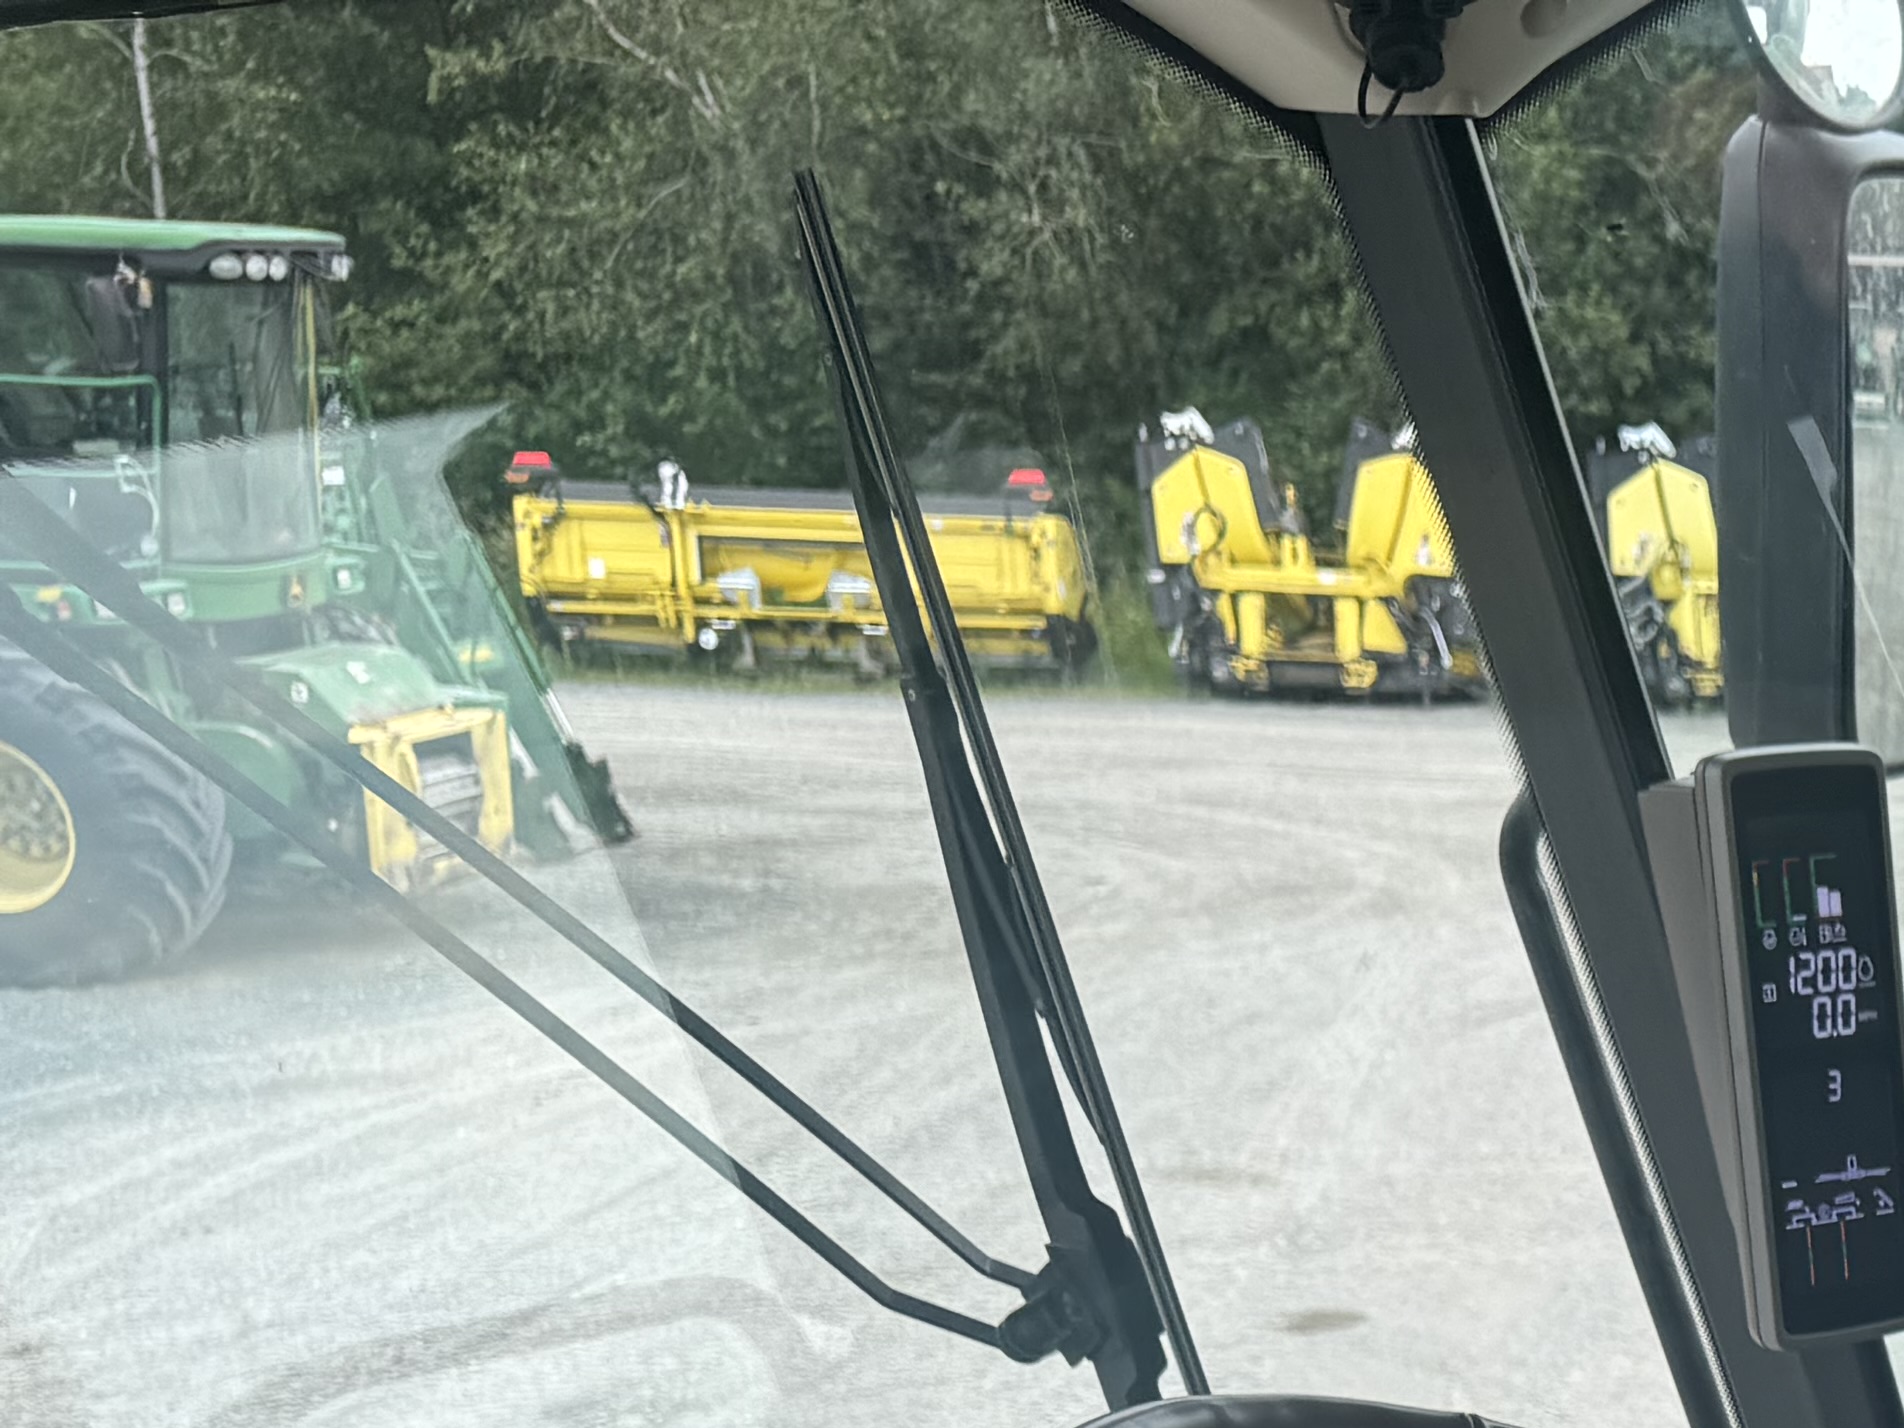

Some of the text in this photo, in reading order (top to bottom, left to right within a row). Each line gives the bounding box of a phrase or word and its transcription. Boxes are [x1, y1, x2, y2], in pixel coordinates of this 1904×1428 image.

[1789, 948, 1857, 994] 1200
[1813, 994, 1857, 1039] 0.0
[1828, 1069, 1842, 1102] 3
